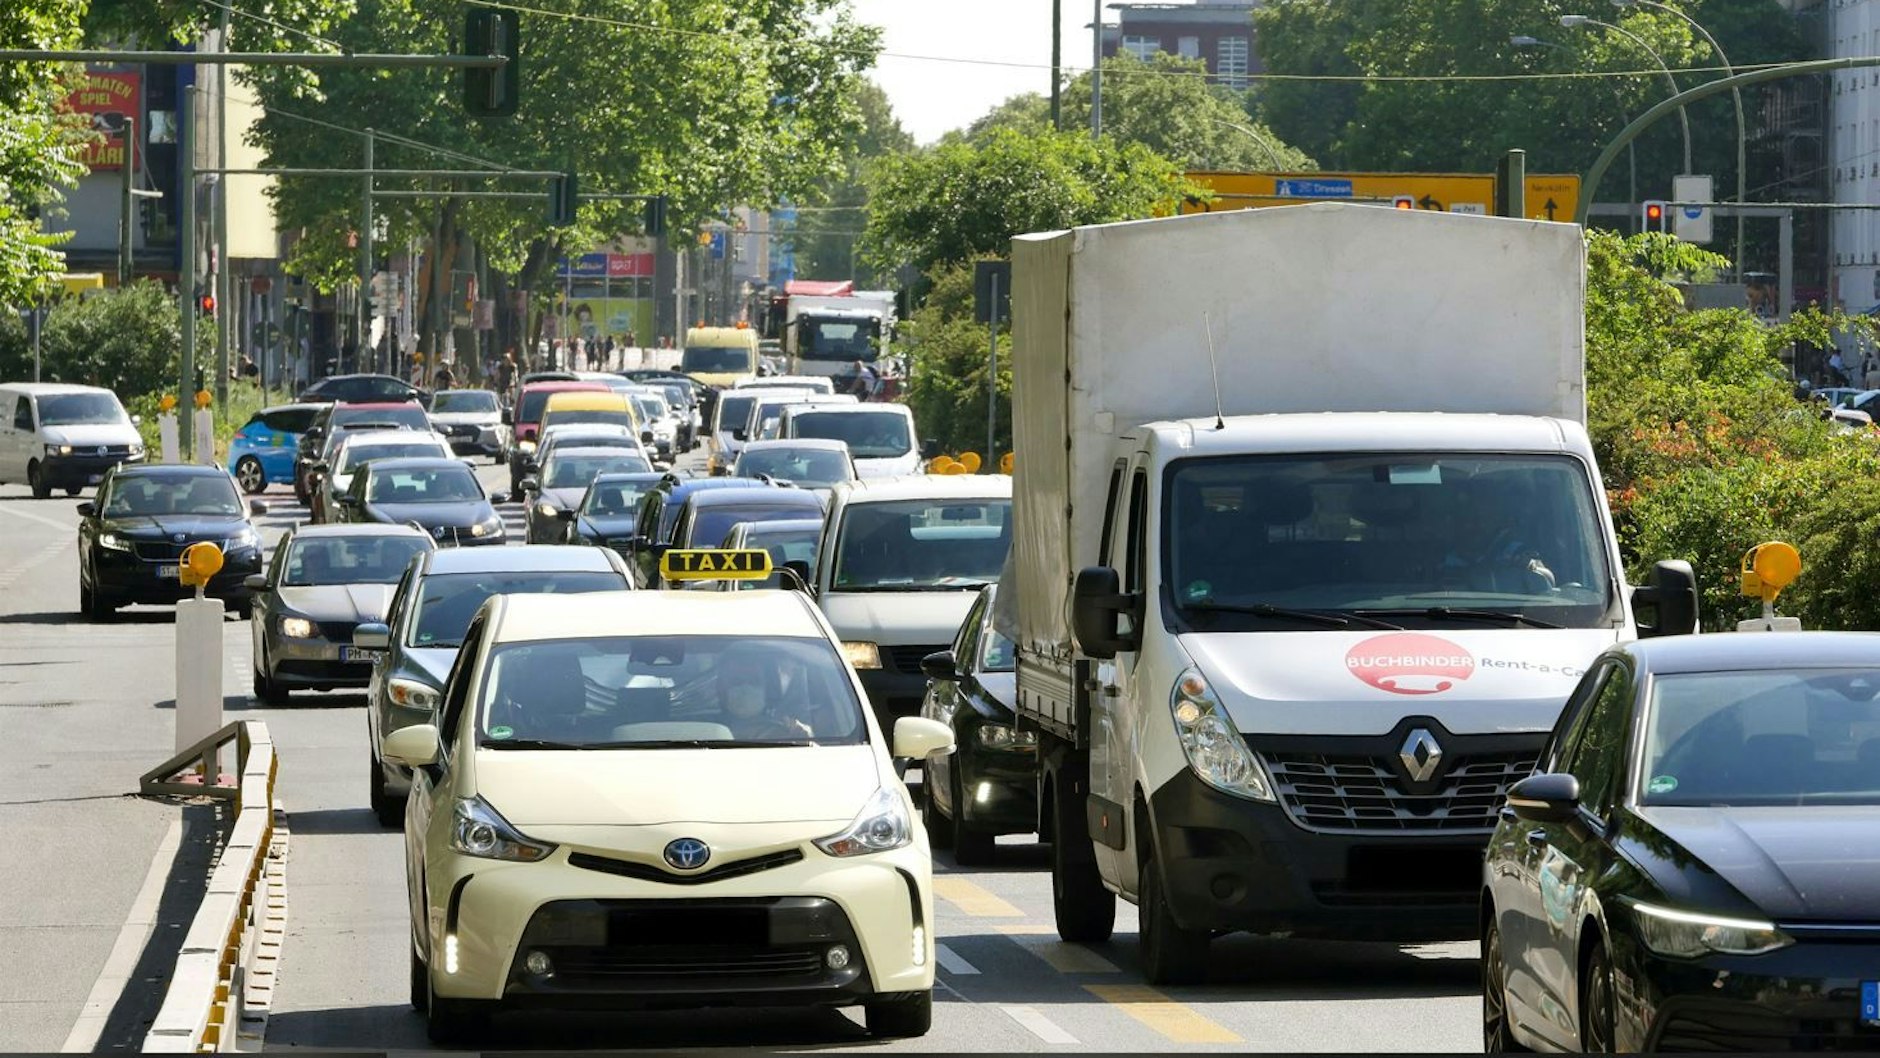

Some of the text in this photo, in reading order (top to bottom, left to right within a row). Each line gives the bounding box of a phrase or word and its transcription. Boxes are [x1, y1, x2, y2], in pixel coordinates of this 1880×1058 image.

[80, 92, 112, 105] SPIEL
[680, 553, 751, 570] TAXI
[1347, 655, 1586, 677] BUCHBINDER Rent-a-Ca
[1866, 1004, 1874, 1014] D
